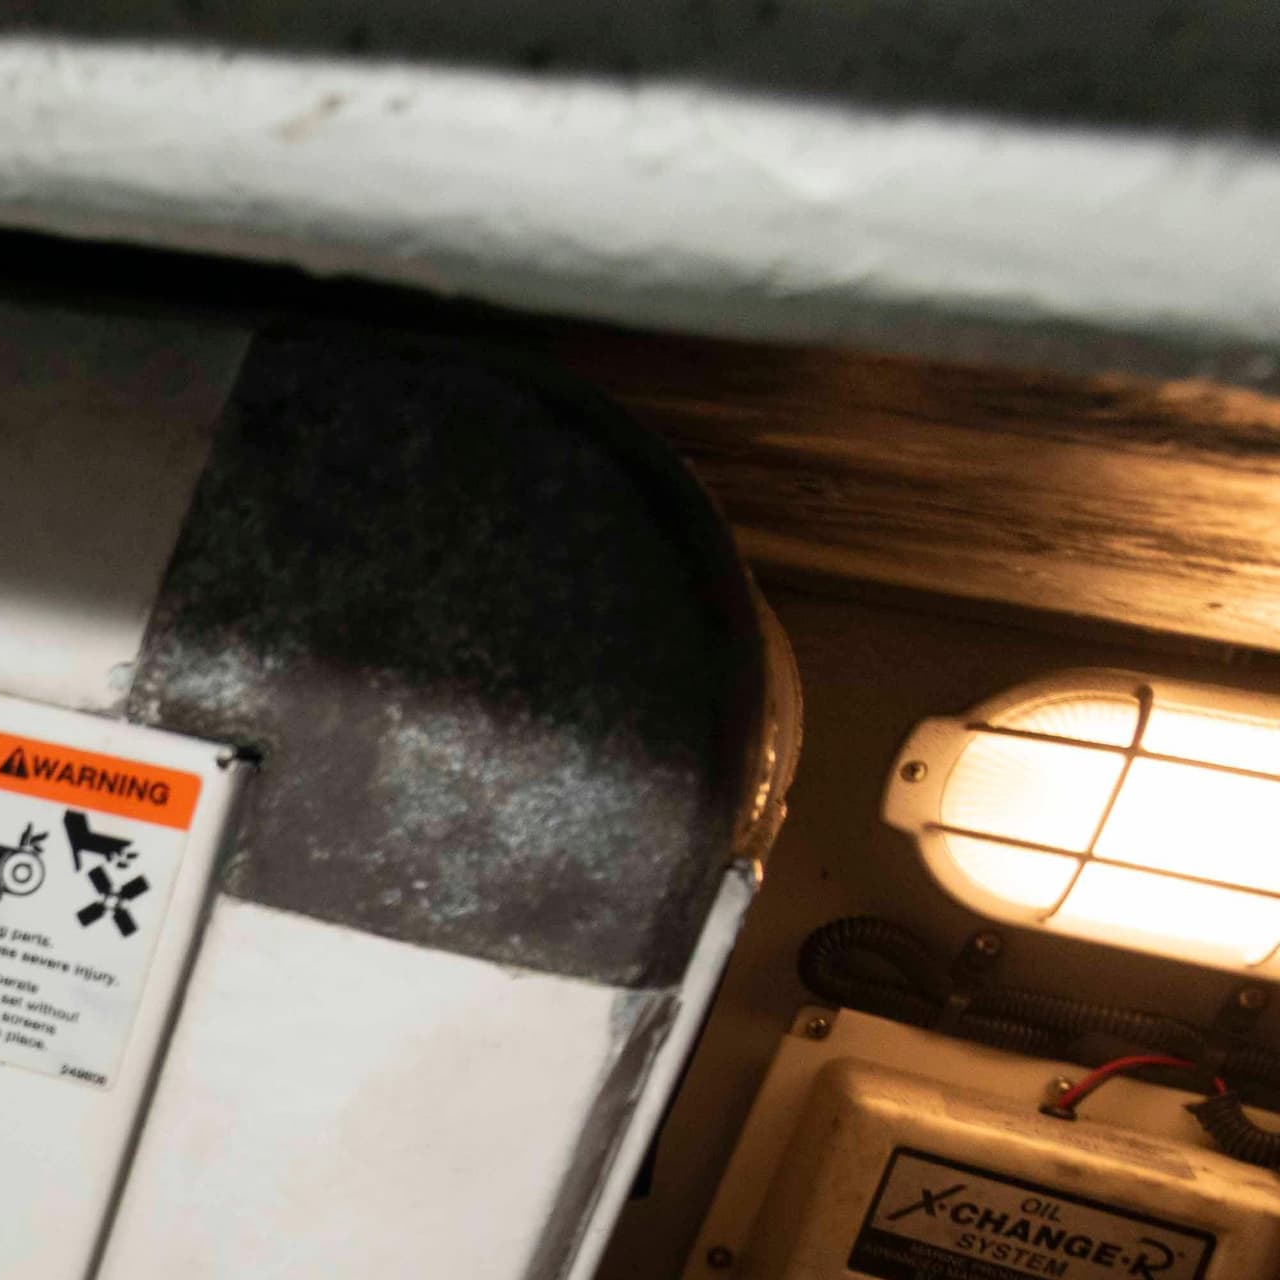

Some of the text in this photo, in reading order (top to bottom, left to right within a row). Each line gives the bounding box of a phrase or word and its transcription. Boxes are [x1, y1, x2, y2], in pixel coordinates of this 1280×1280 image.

[33, 754, 171, 806] WARNING
[21, 952, 70, 973] severe
[0, 994, 23, 1007] set
[26, 1000, 80, 1023] without
[1, 1012, 57, 1035] screens
[1020, 1198, 1061, 1223] OIL
[956, 1233, 1069, 1277] SYSTEM
